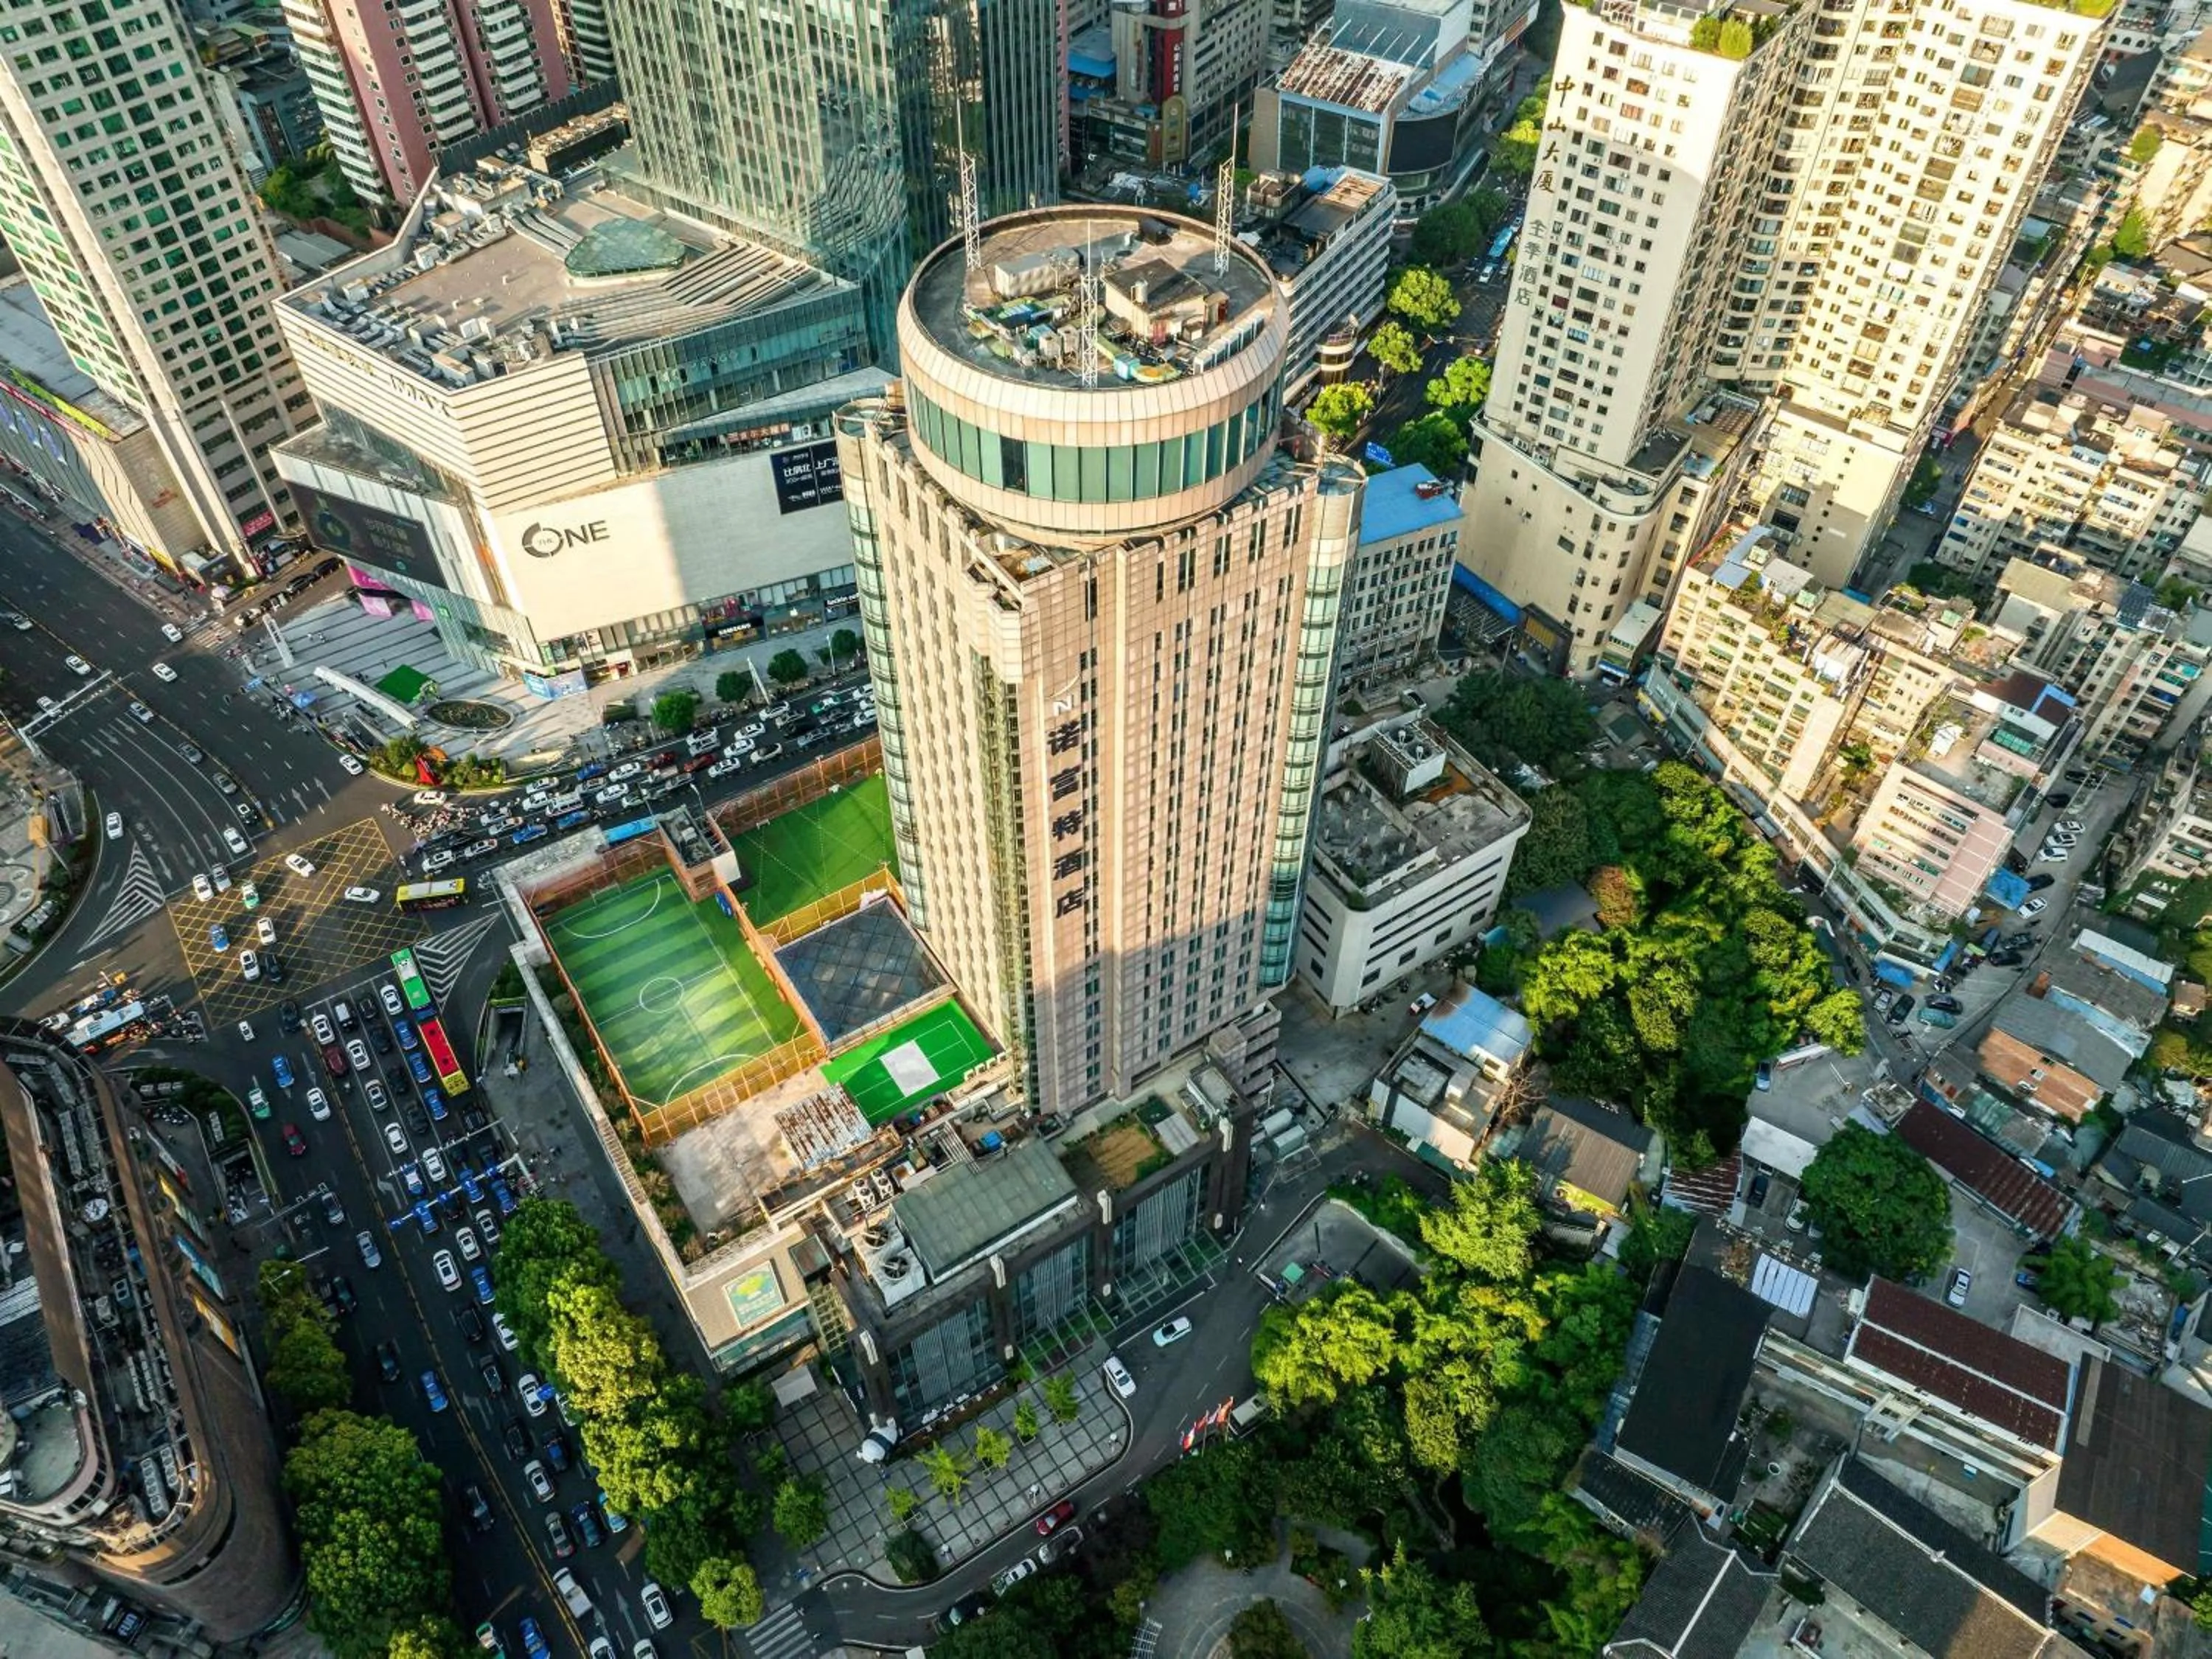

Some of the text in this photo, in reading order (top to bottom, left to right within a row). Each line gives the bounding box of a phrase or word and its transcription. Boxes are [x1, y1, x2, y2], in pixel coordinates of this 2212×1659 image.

[1533, 74, 1576, 194] 中山大厦
[1514, 219, 1546, 306] 全季酒店
[521, 519, 611, 558] ONE
[1047, 719, 1085, 919] 诺富特酒店
